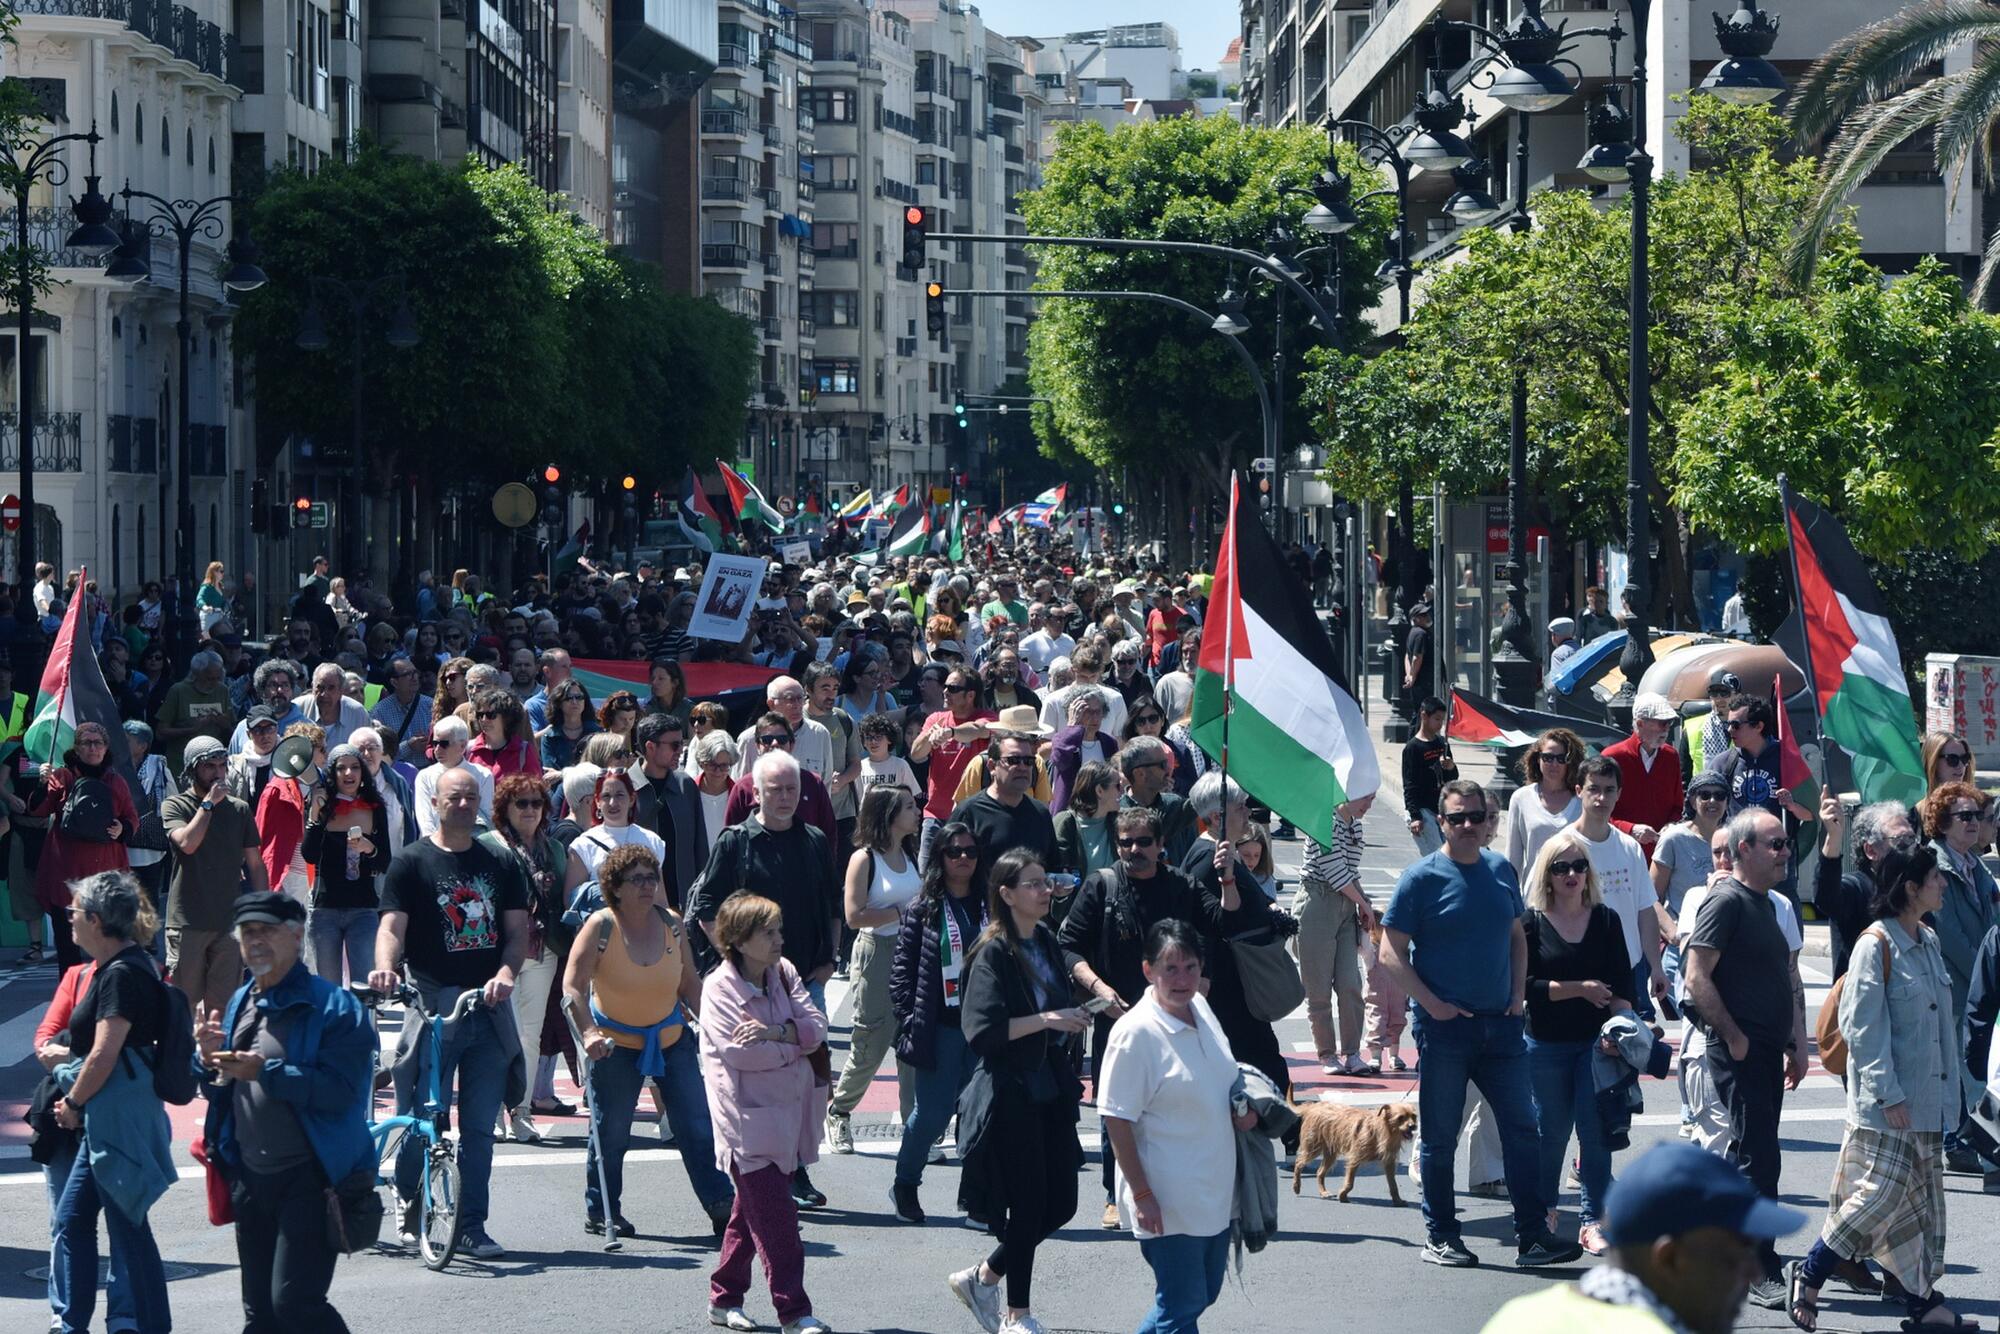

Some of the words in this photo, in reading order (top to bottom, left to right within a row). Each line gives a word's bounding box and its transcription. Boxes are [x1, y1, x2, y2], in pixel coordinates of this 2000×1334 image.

[730, 569, 752, 578] GAZA
[862, 774, 886, 785] TIGER
[888, 773, 896, 784] IN
